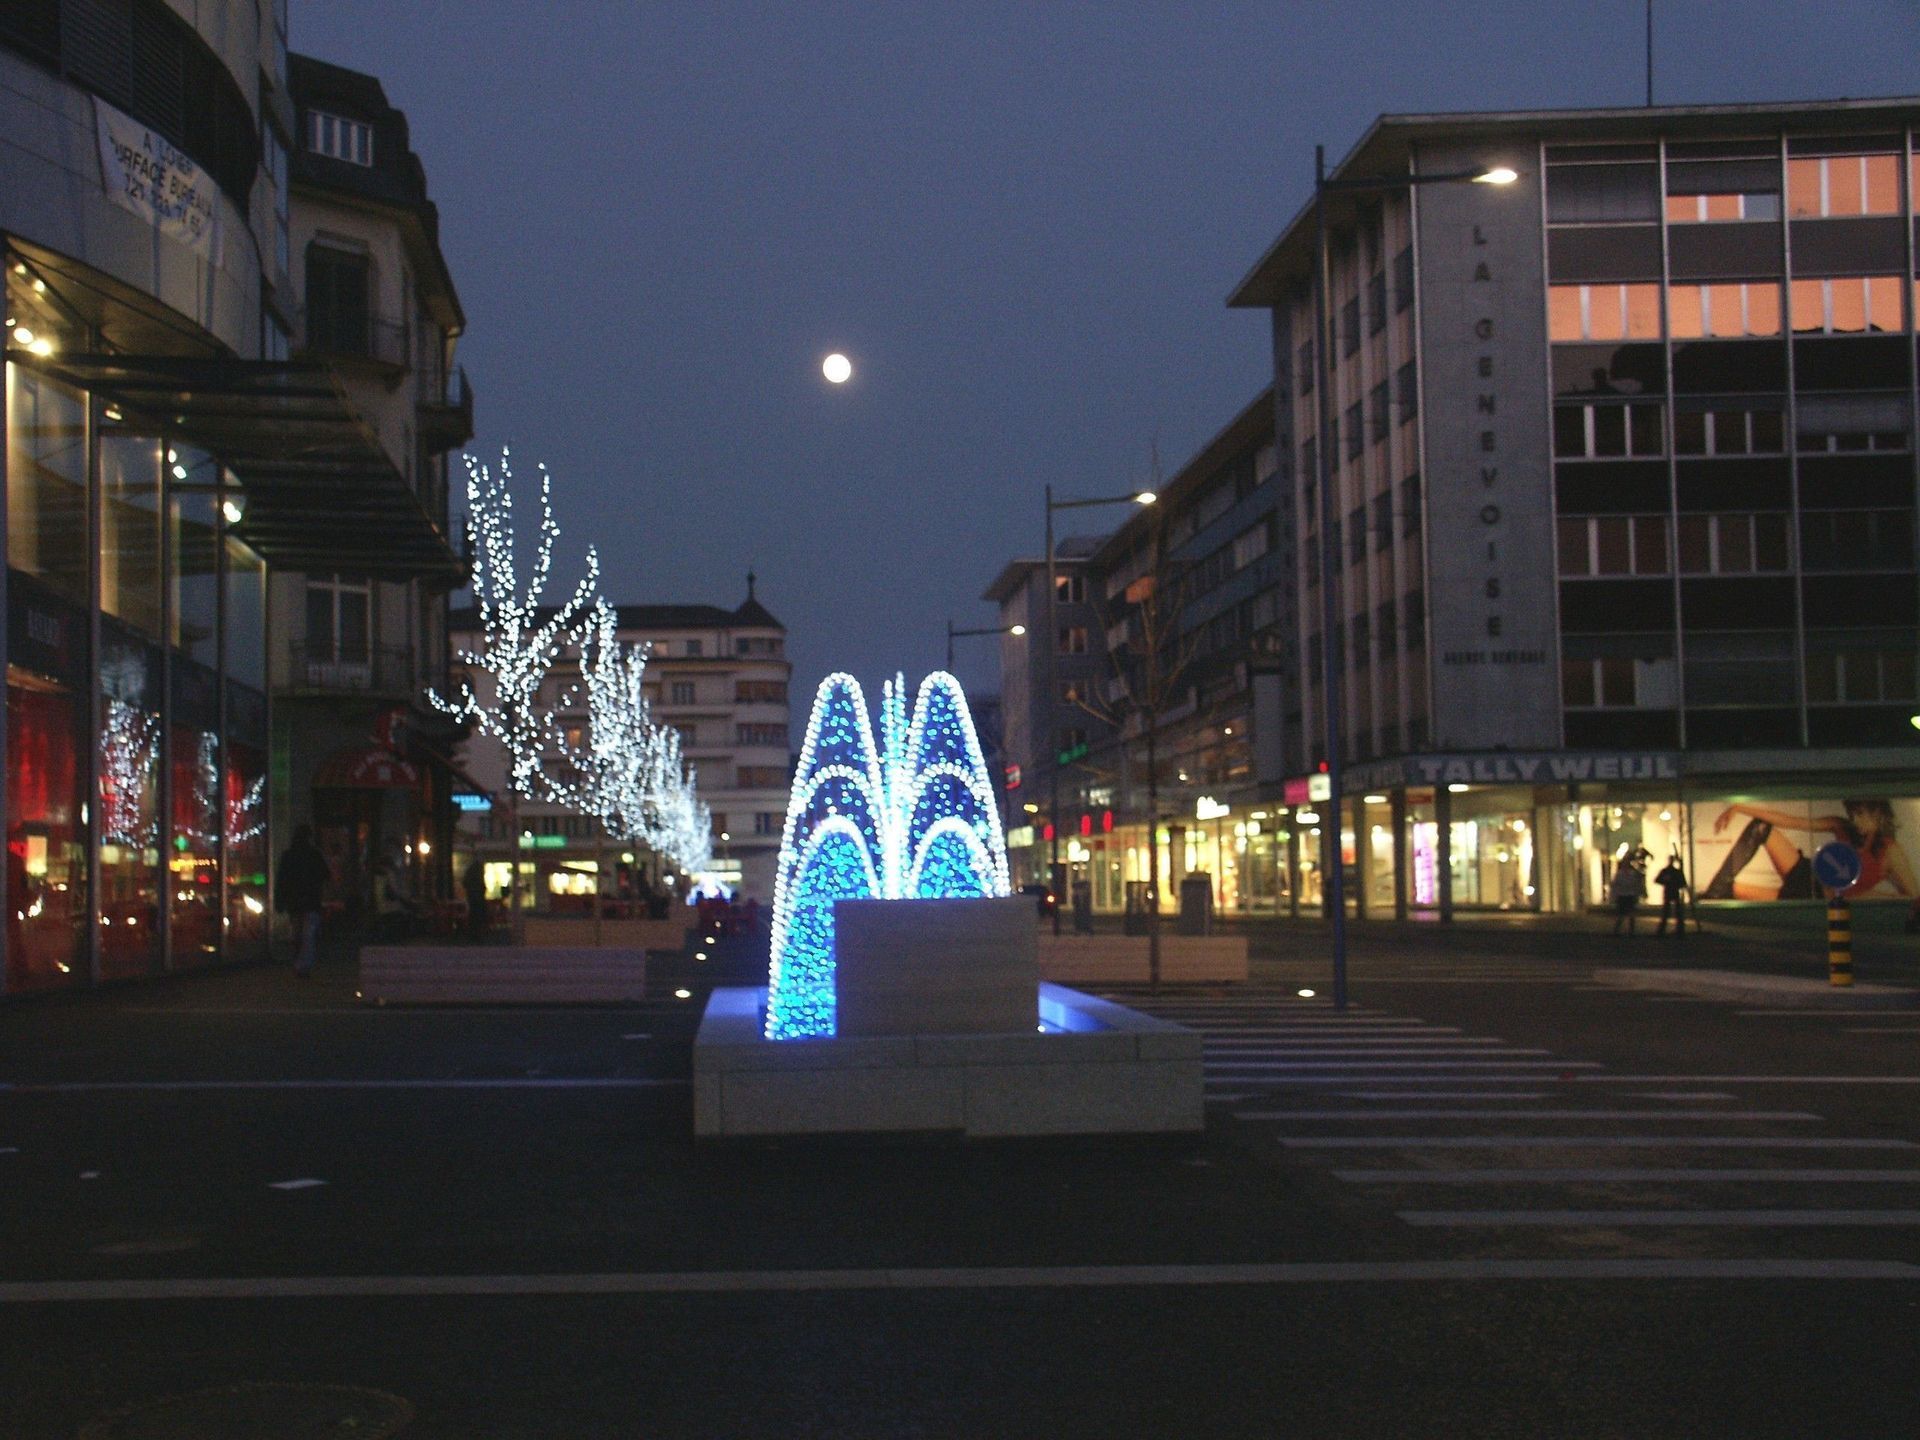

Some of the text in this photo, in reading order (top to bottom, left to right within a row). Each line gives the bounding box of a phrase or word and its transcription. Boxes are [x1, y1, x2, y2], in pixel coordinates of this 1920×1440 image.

[142, 131, 153, 154] A
[1473, 226, 1500, 636] LA GENEVOISE
[1419, 759, 1541, 781] TALLY
[1550, 757, 1678, 779] WEIJL
